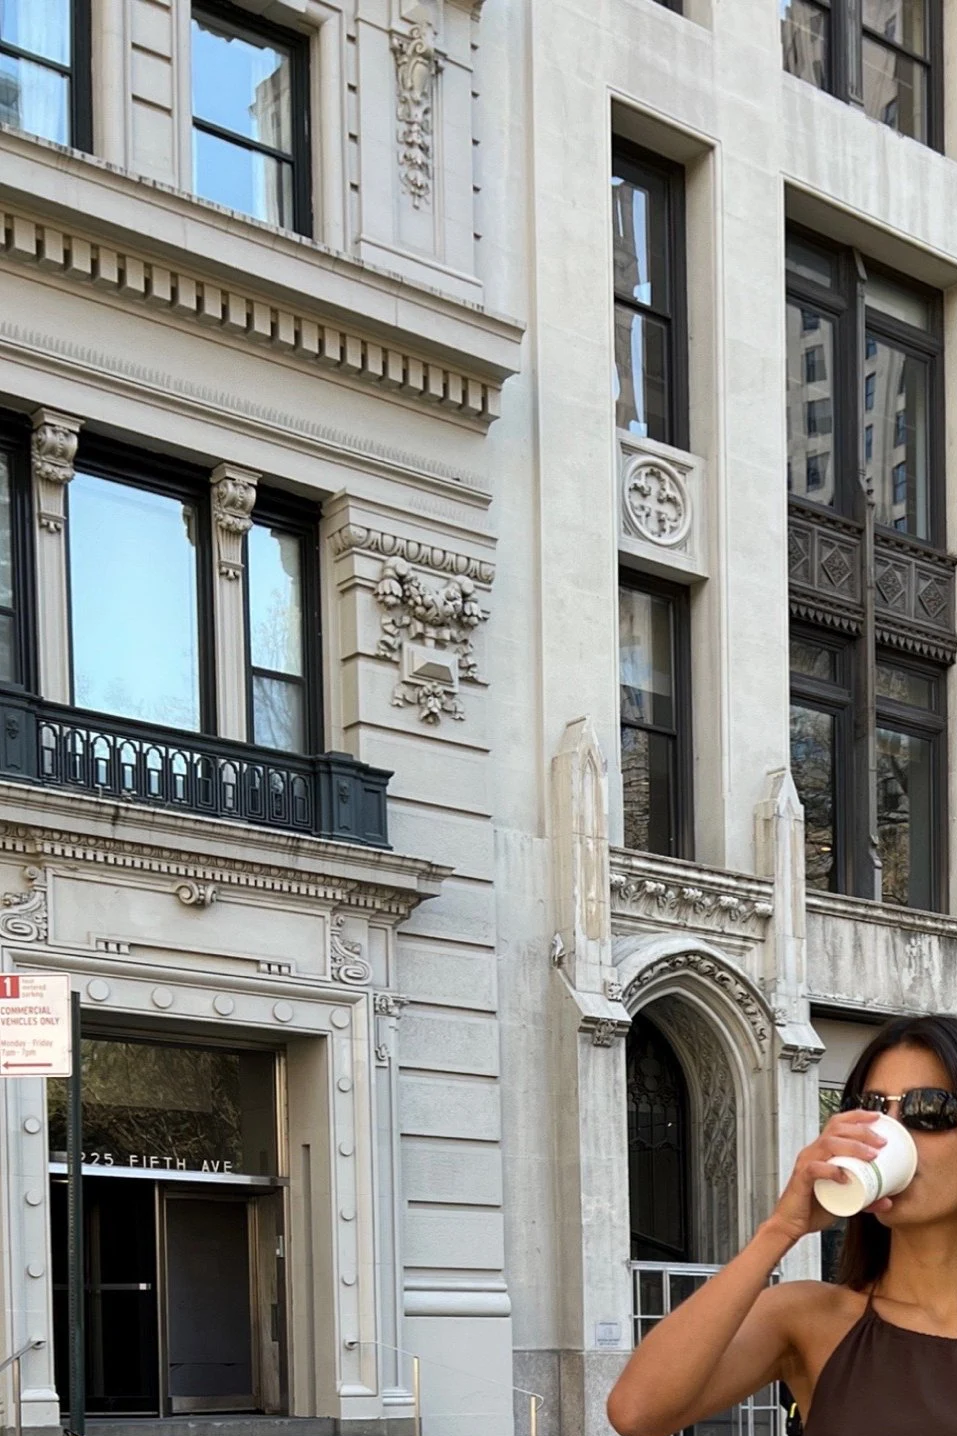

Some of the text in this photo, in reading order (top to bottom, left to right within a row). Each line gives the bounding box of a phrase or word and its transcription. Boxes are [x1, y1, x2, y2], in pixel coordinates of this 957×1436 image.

[4, 977, 11, 996] 1
[0, 1006, 51, 1015] COMMERCIAL
[0, 1017, 60, 1026] VEHICLES ONLY
[129, 1154, 186, 1171] FIFTH
[201, 1160, 233, 1174] AVE
